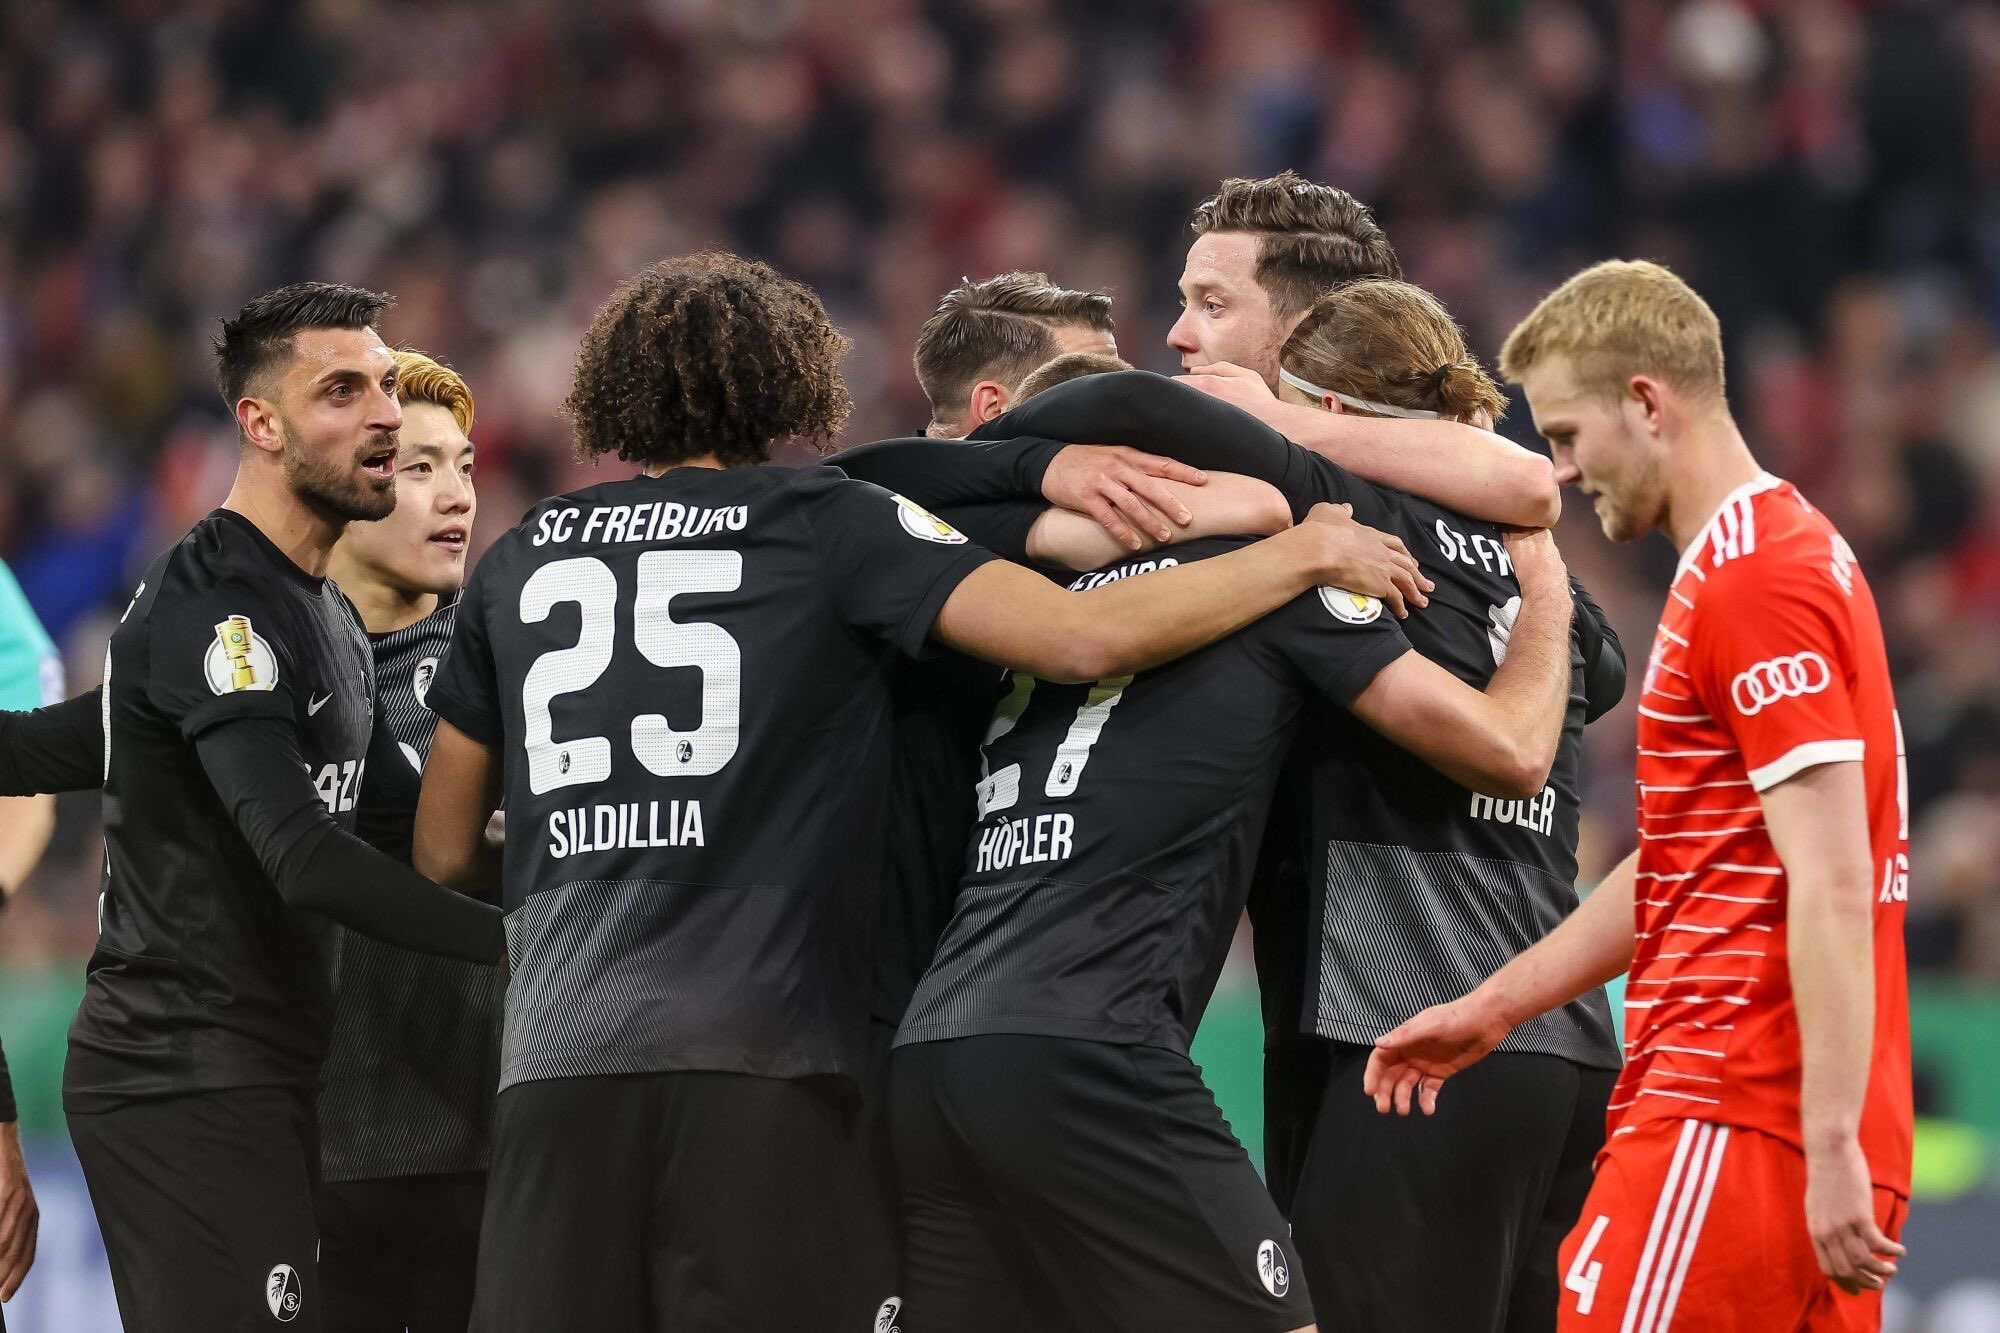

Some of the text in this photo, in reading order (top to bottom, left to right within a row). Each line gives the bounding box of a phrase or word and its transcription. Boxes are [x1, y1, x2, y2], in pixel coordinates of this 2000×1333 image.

[532, 508, 580, 547] SC
[519, 549, 743, 796] 25
[548, 800, 705, 859] SILDILLIA
[976, 813, 1075, 873] HÖFLER
[1564, 1215, 1610, 1315] 4
